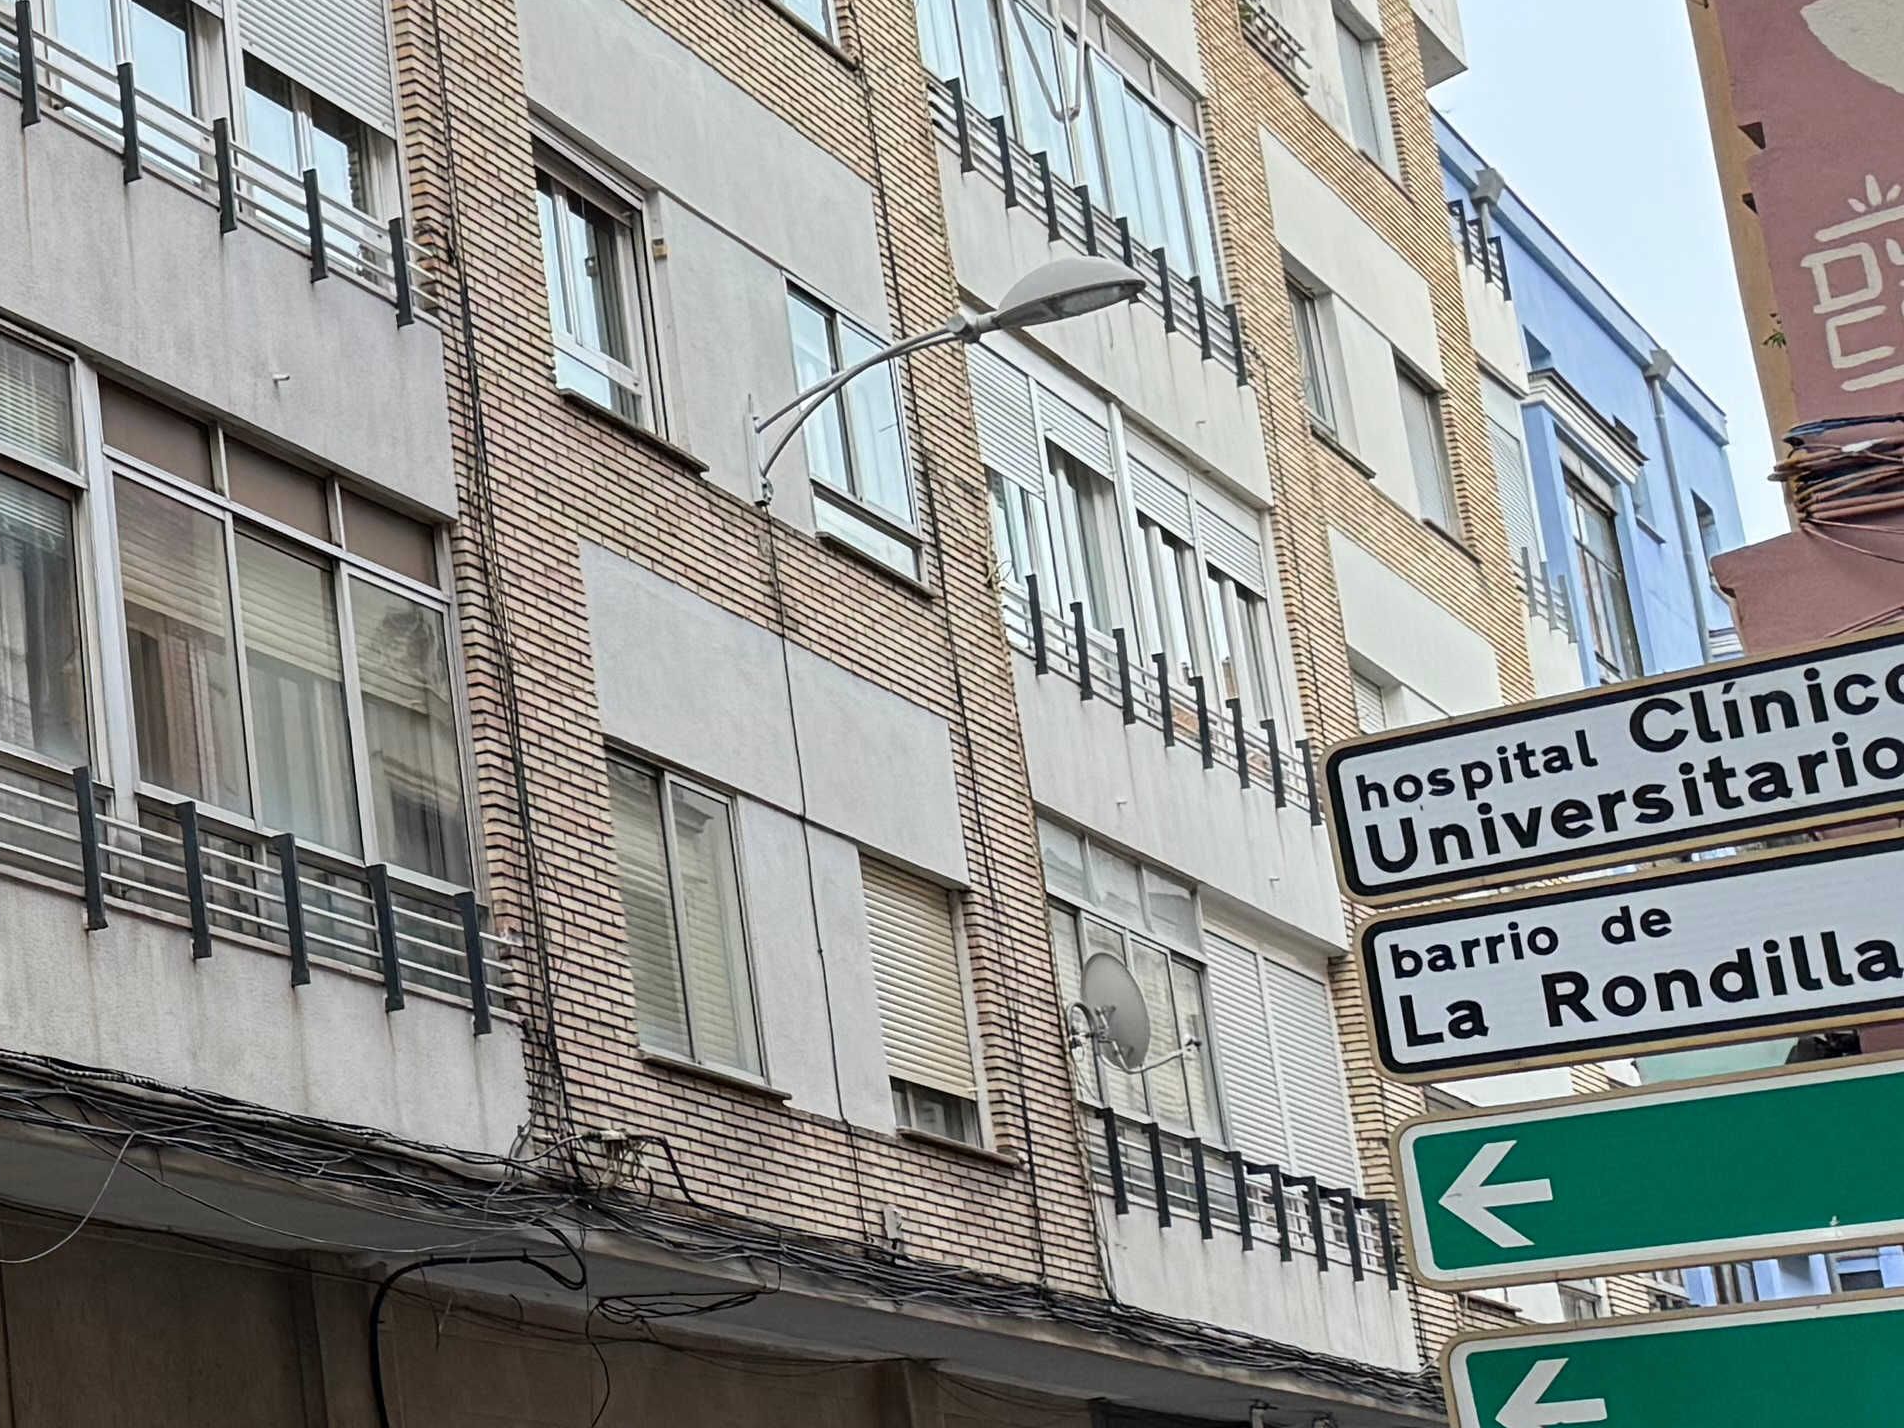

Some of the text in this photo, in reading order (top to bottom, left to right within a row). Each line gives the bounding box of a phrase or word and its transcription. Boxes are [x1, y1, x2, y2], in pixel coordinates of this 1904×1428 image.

[1355, 729, 1598, 813] hospital
[1364, 731, 1904, 874] Universitario
[1389, 904, 1673, 979] barrio de
[1399, 931, 1904, 1048] La Rondilla
